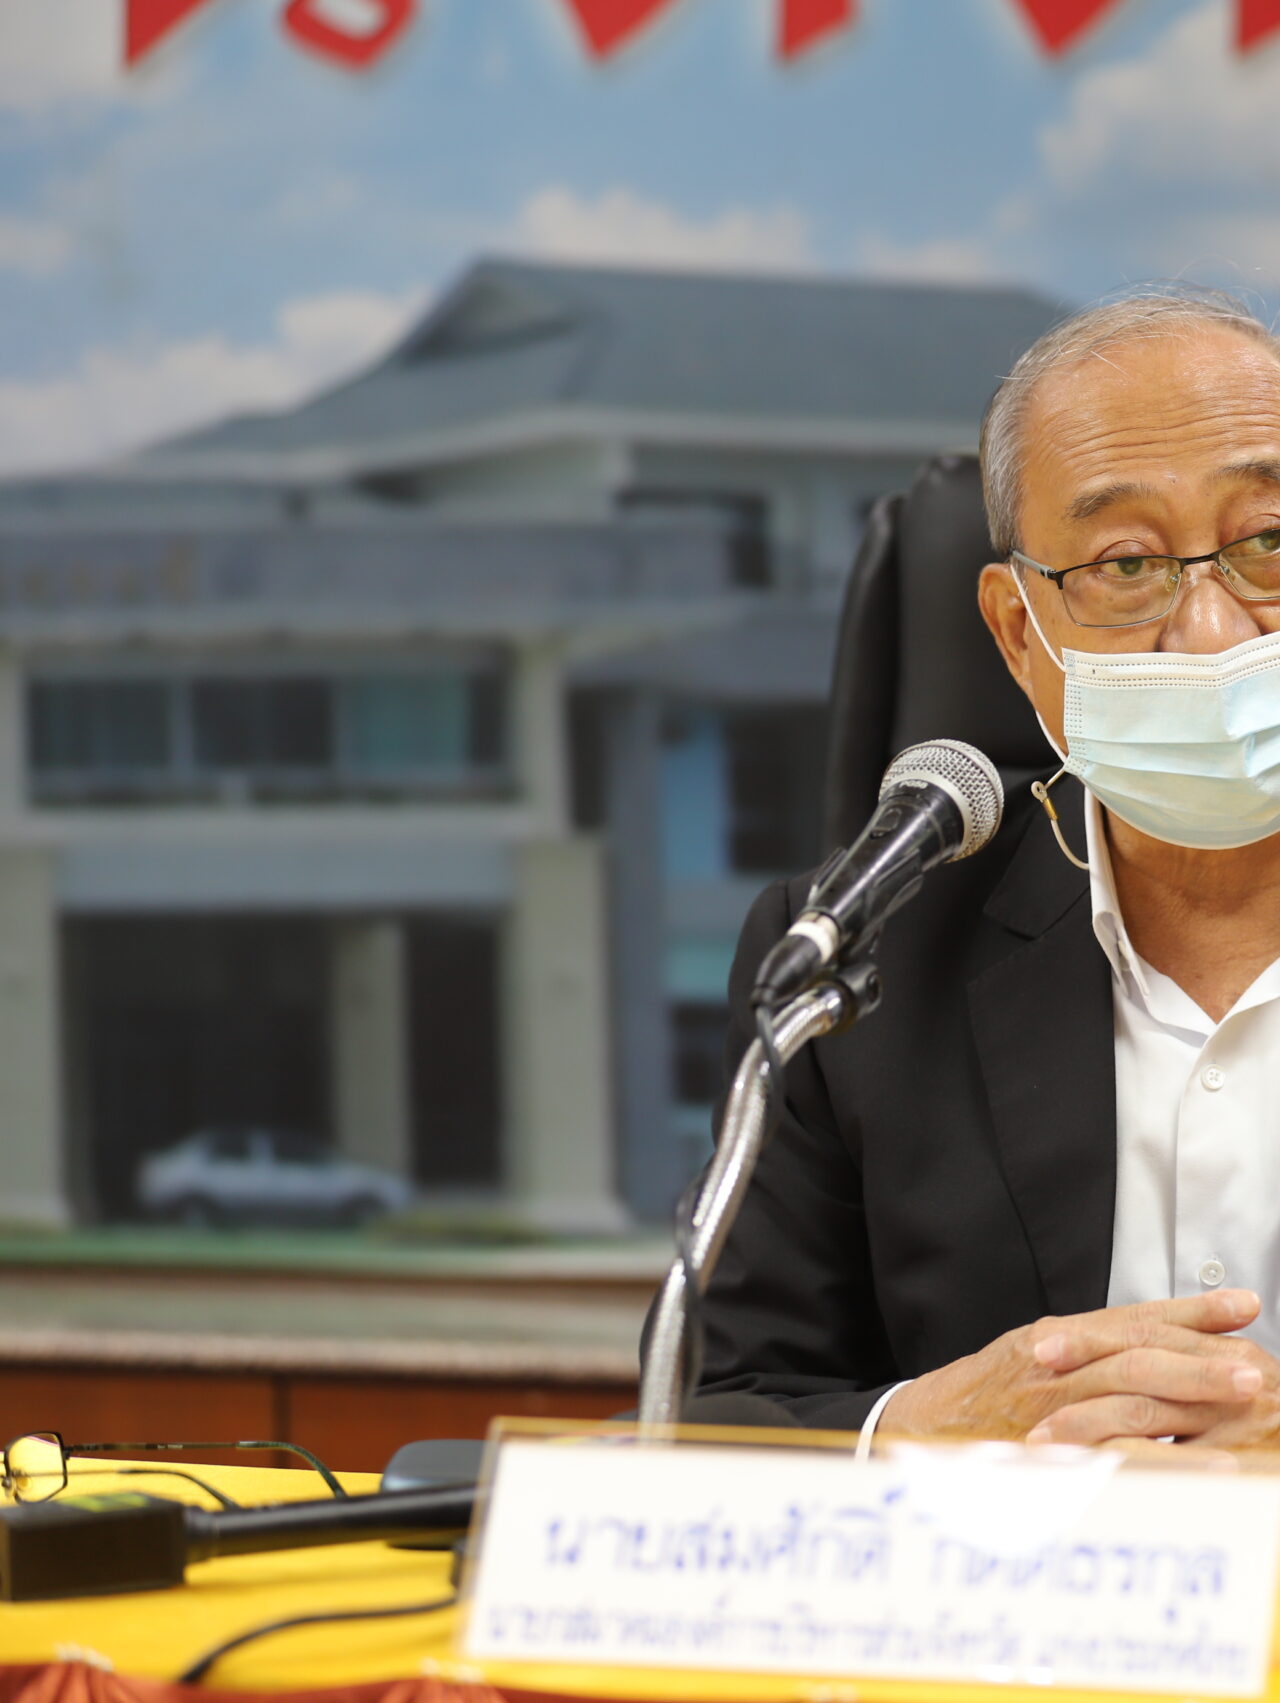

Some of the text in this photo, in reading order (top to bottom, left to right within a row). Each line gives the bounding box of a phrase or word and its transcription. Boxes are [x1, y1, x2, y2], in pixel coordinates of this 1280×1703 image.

[545, 1485, 907, 1579] นายสมศักดิ์
